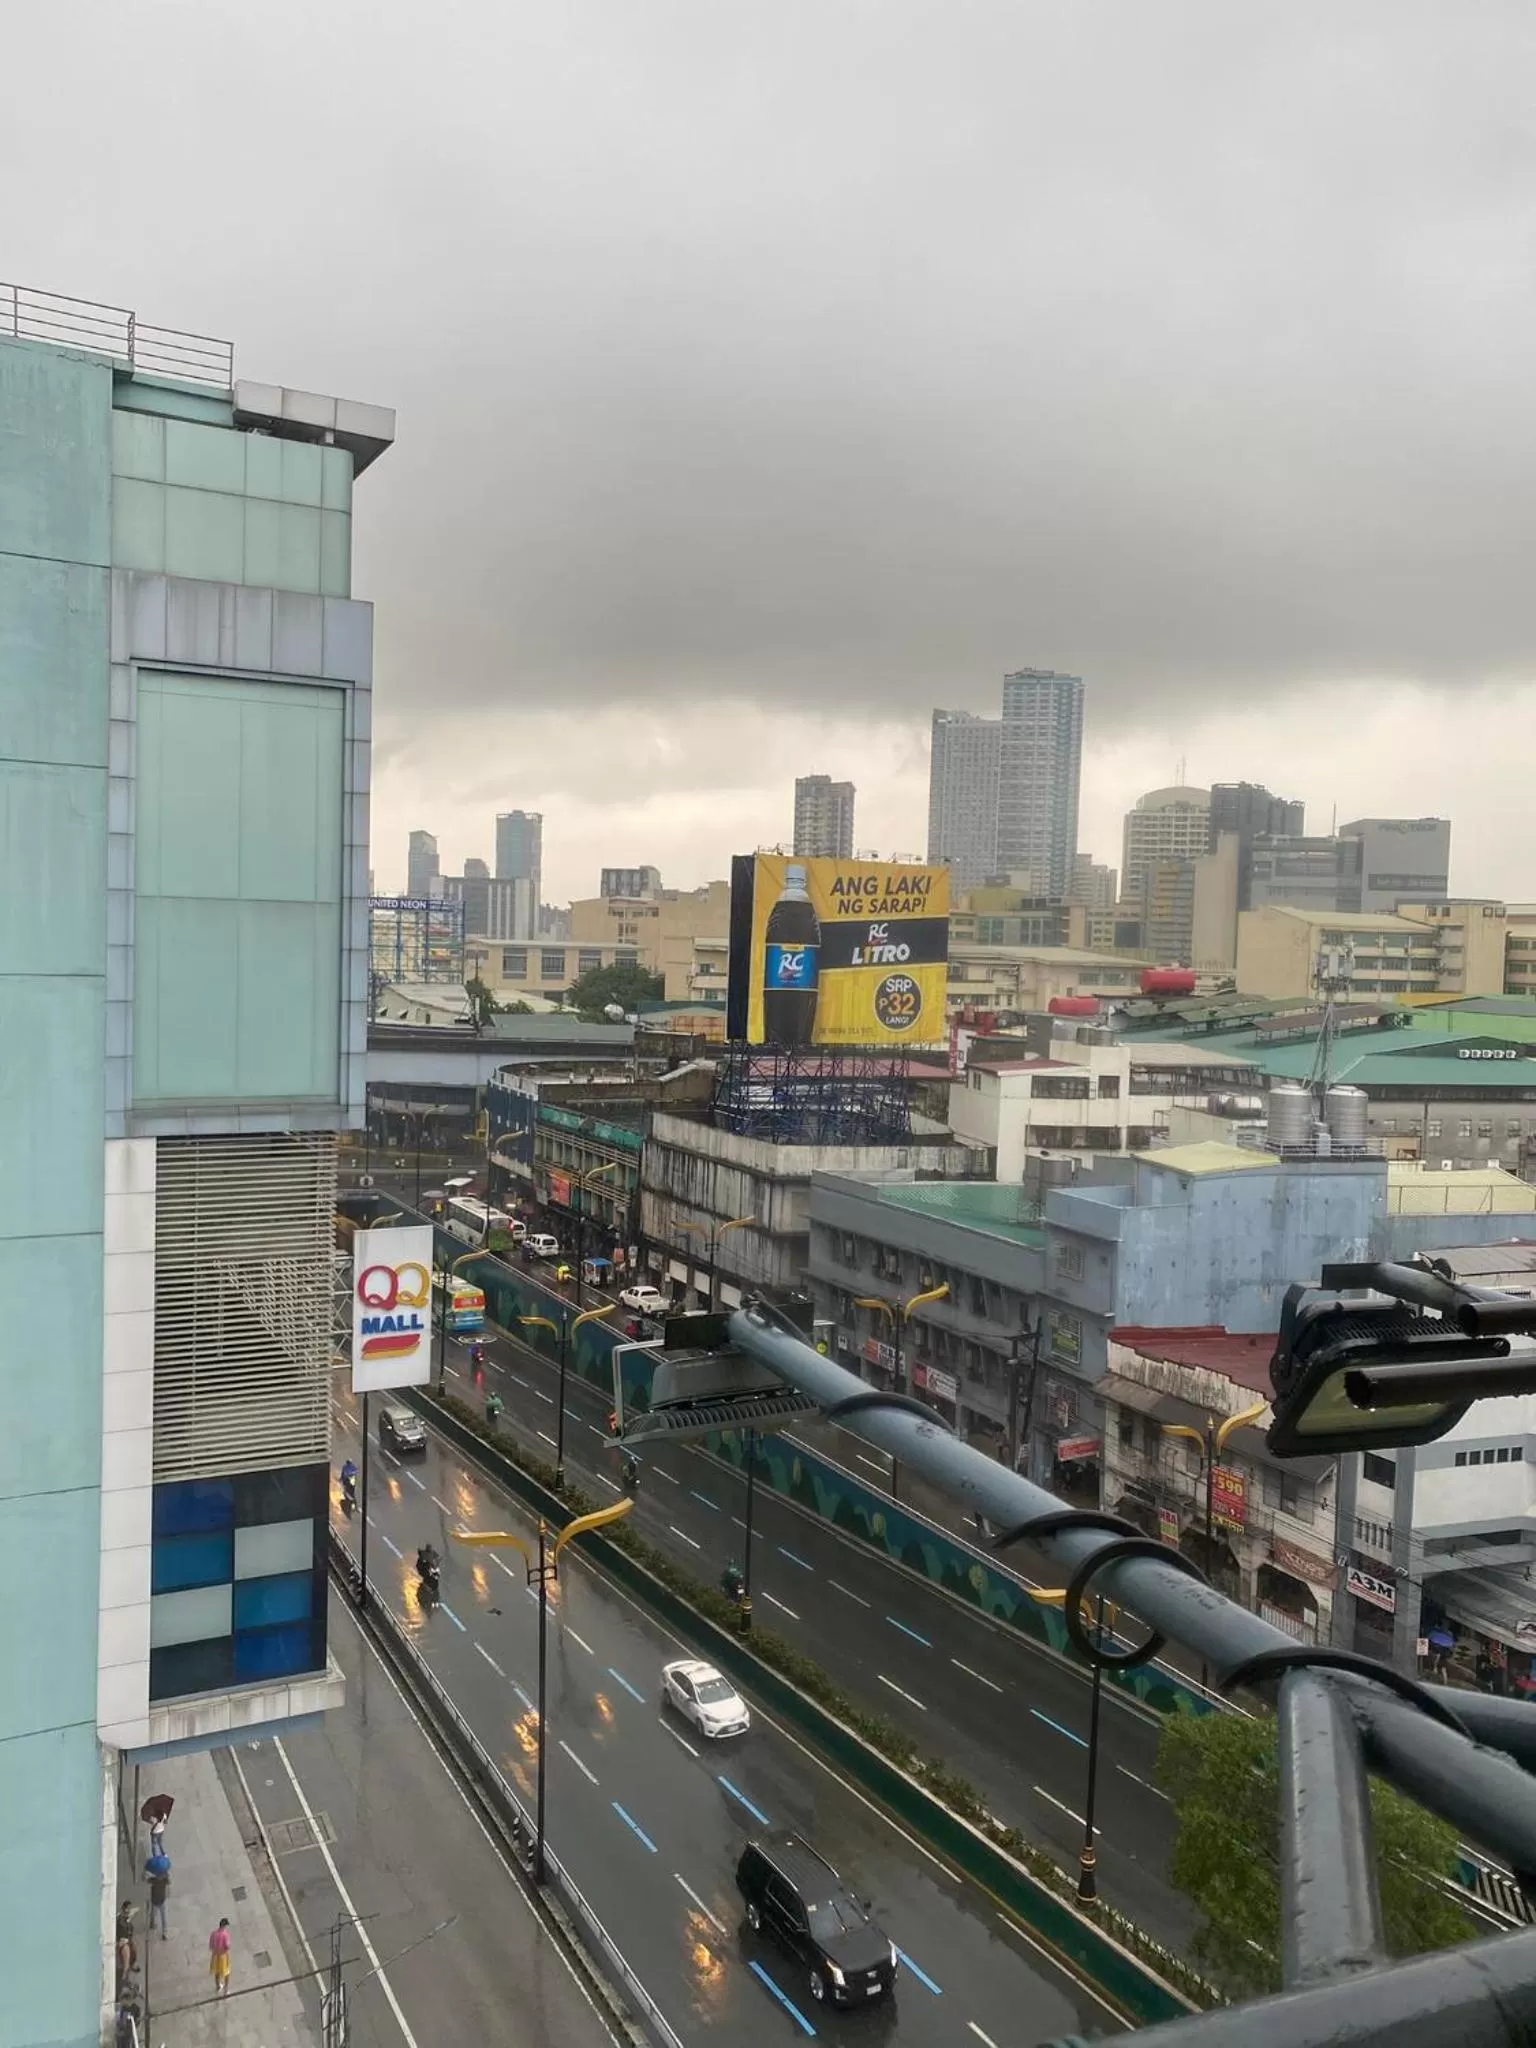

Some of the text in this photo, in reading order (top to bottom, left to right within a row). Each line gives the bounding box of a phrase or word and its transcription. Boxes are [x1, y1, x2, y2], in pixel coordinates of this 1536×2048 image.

[830, 875, 932, 896] ANG LAKI
[368, 898, 398, 908] UNITED
[400, 900, 427, 909] NEON
[838, 897, 927, 914] NG SARAP!
[868, 923, 889, 942] RC
[778, 953, 805, 974] RC
[885, 978, 912, 993] SRP
[357, 1262, 431, 1311] QQ
[361, 1314, 424, 1335] MALL
[1350, 1571, 1393, 1600] A3M
